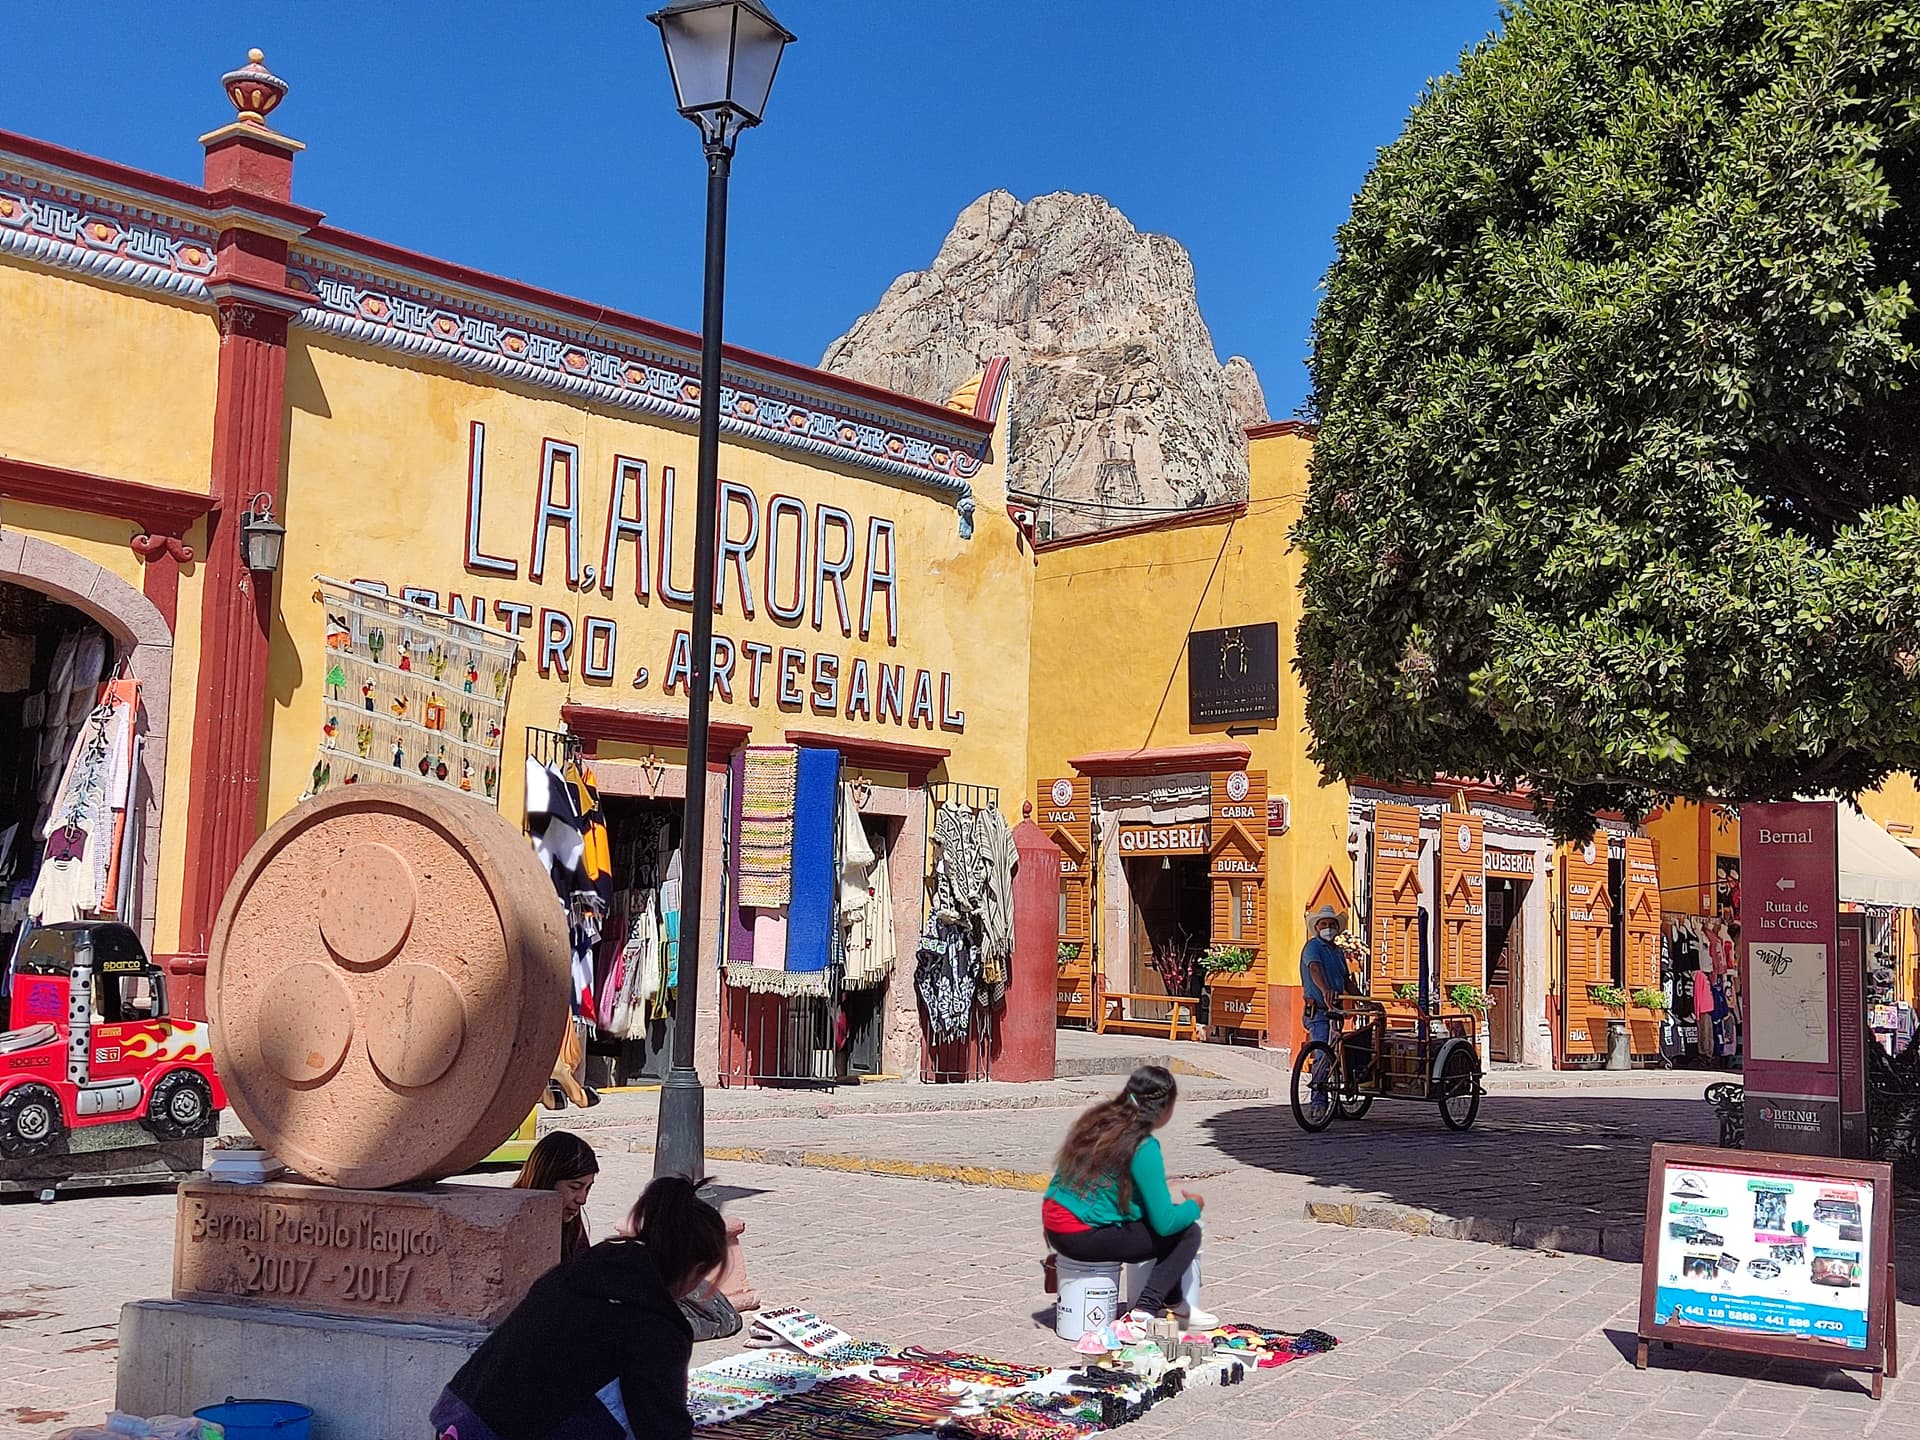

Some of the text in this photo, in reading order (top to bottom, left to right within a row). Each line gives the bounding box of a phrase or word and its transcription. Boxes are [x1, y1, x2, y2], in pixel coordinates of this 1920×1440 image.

[601, 453, 897, 646] AURORA
[664, 630, 964, 732] ARTESANAL
[1048, 811, 1076, 822] VACA
[1221, 806, 1255, 817] CABRA
[1120, 823, 1210, 850] QUESERÍA
[1759, 828, 1813, 844] Bernal
[1217, 858, 1258, 872] BÚFALA
[1485, 852, 1534, 873] QUESERÍA
[1765, 901, 1809, 913] Ruta de
[1760, 917, 1819, 929] las Cruces
[103, 960, 141, 970] sparco
[1224, 999, 1252, 1013] FRÍAS
[9, 1056, 49, 1066] sparco
[192, 1203, 436, 1262] Bernal Pueblo Magico
[246, 1252, 318, 1294] 2007
[342, 1262, 415, 1303] 2017
